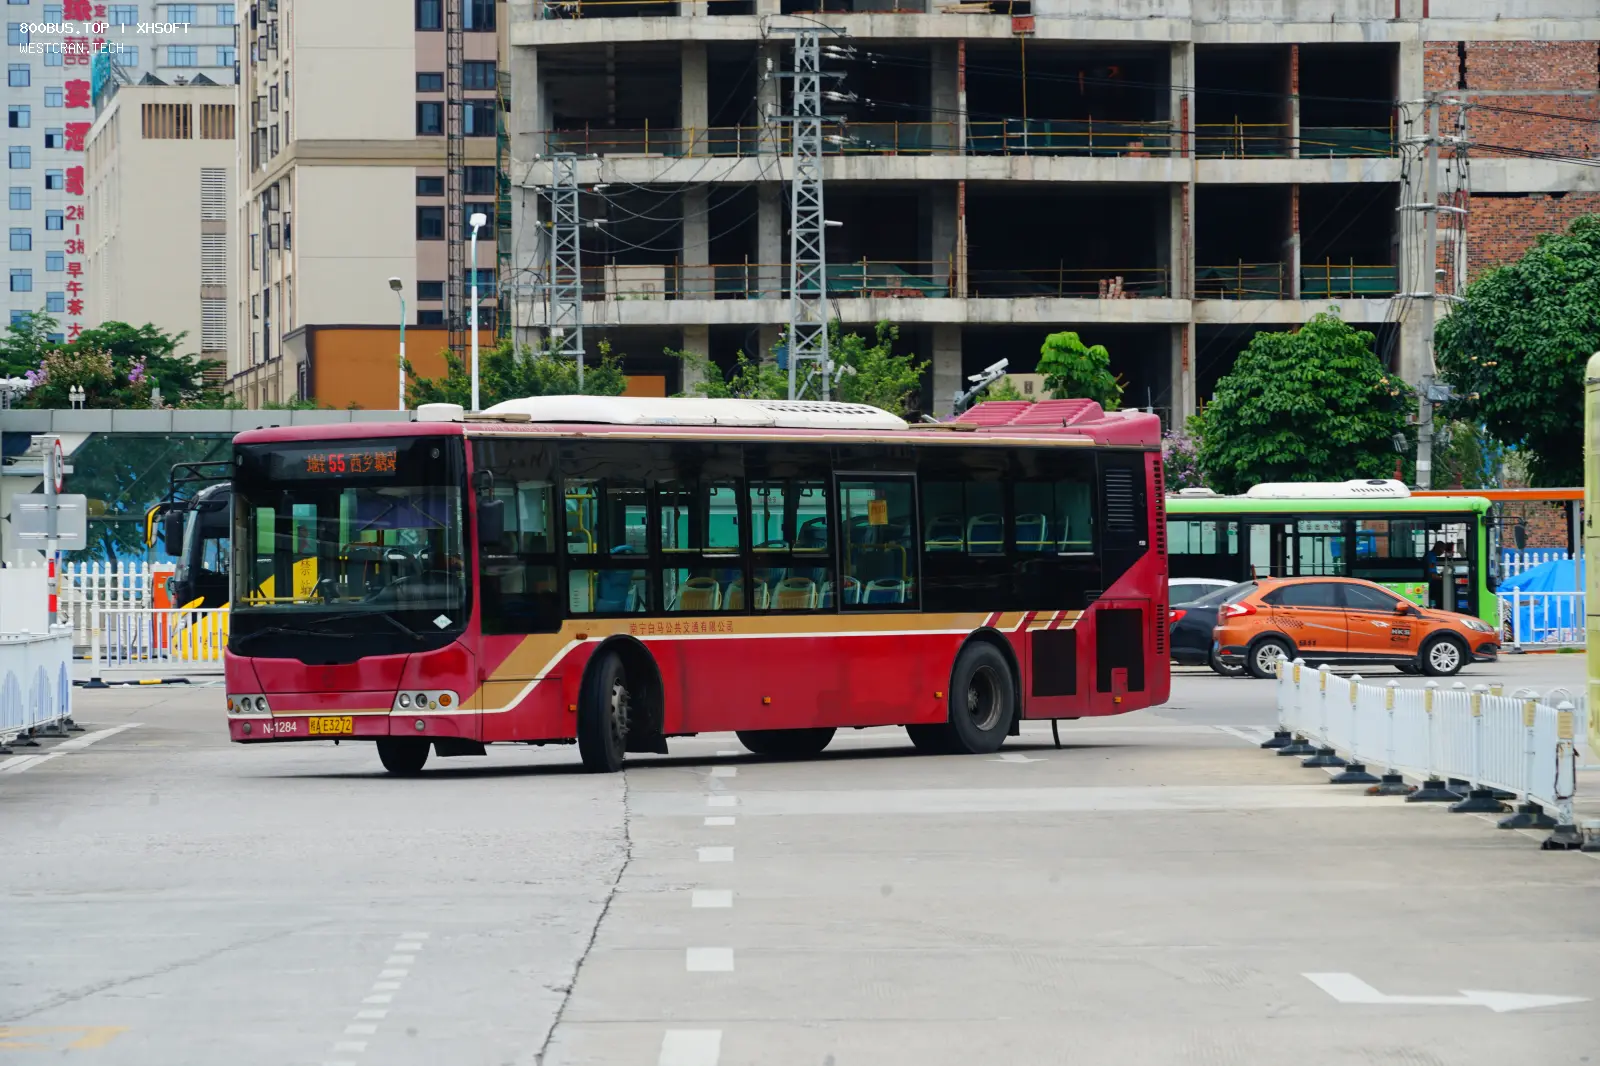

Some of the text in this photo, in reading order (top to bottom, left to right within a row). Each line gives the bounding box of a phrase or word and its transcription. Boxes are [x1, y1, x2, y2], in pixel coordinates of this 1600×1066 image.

[328, 453, 346, 472] 55
[629, 620, 734, 635] 南宁白马公共交通有限公司
[263, 721, 297, 734] N-1284
